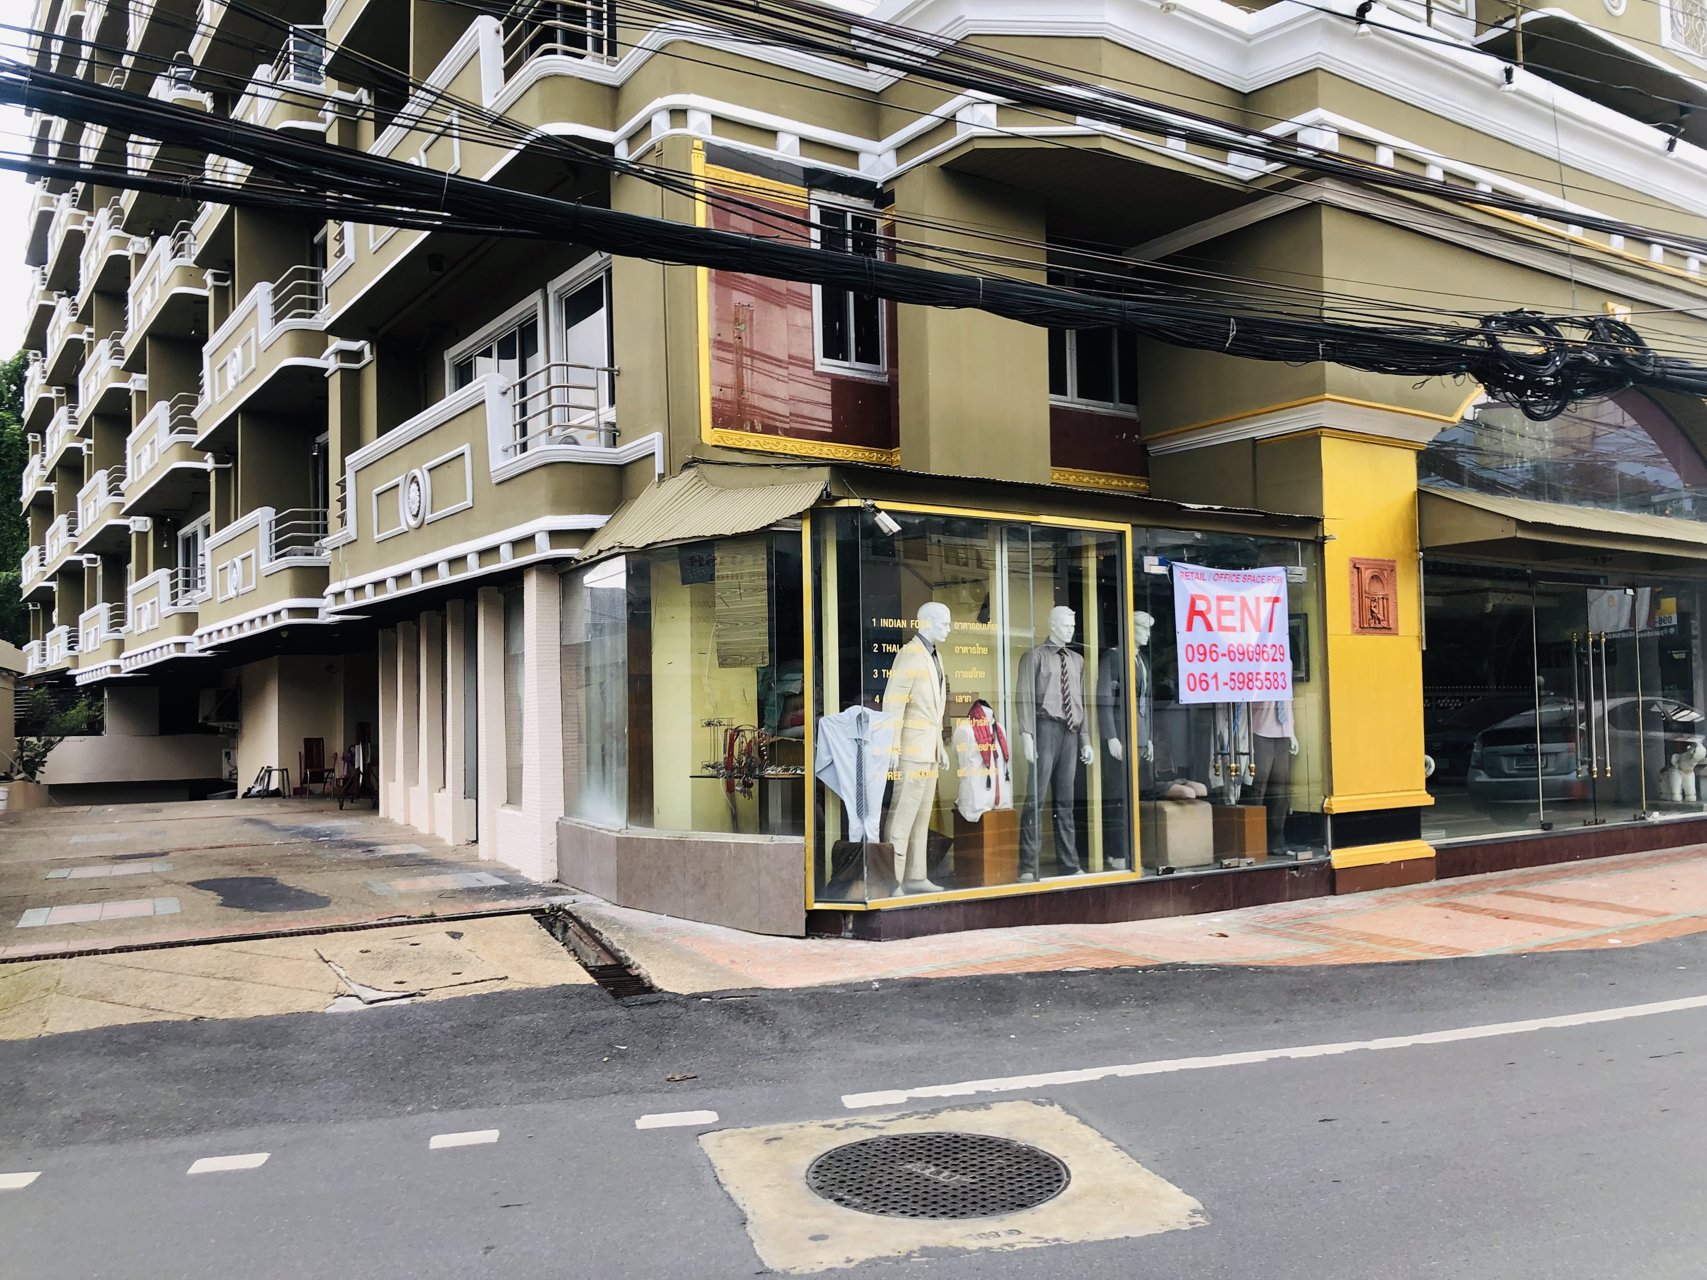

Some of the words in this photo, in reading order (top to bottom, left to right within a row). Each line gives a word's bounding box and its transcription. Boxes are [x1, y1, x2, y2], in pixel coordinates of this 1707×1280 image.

[1179, 571, 1206, 582] RETAIL
[1212, 573, 1240, 582] OFFICE
[1242, 574, 1266, 584] SPACE
[1267, 575, 1282, 584] FOR
[1185, 593, 1282, 633] RENT
[871, 617, 876, 627] 1
[880, 618, 907, 628] INDIAN
[872, 643, 879, 653] 2
[881, 643, 900, 653] THAI
[954, 643, 988, 655] อาหารไทย
[872, 669, 879, 679] 3
[1186, 671, 1288, 692] 061-5985583
[874, 694, 880, 704] 4
